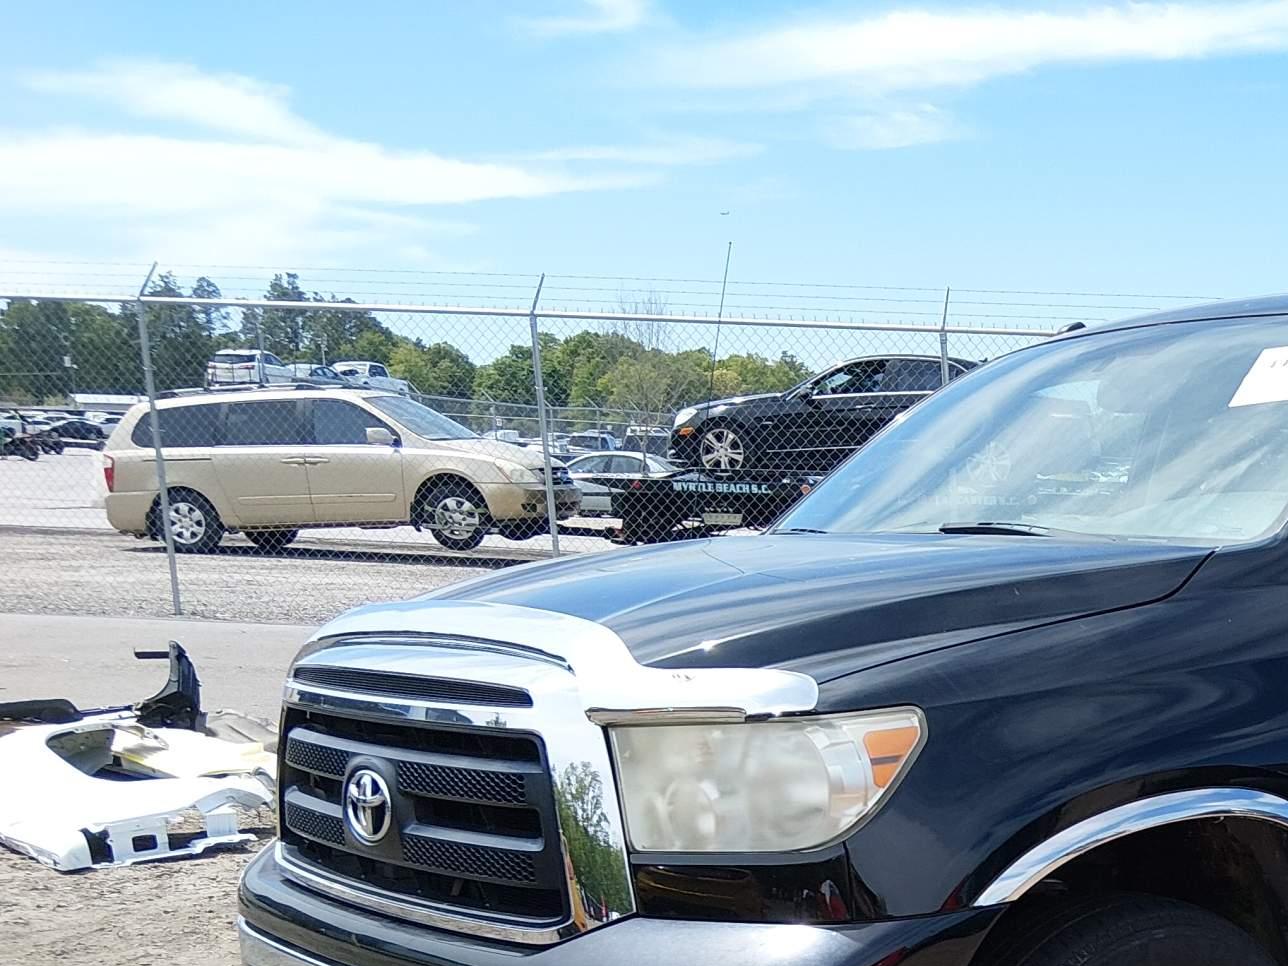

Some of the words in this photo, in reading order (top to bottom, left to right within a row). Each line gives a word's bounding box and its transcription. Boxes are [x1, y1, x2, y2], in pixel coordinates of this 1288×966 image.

[673, 482, 714, 493] MYRTLE
[715, 483, 750, 494] BEACH
[751, 484, 772, 494] S.C.
